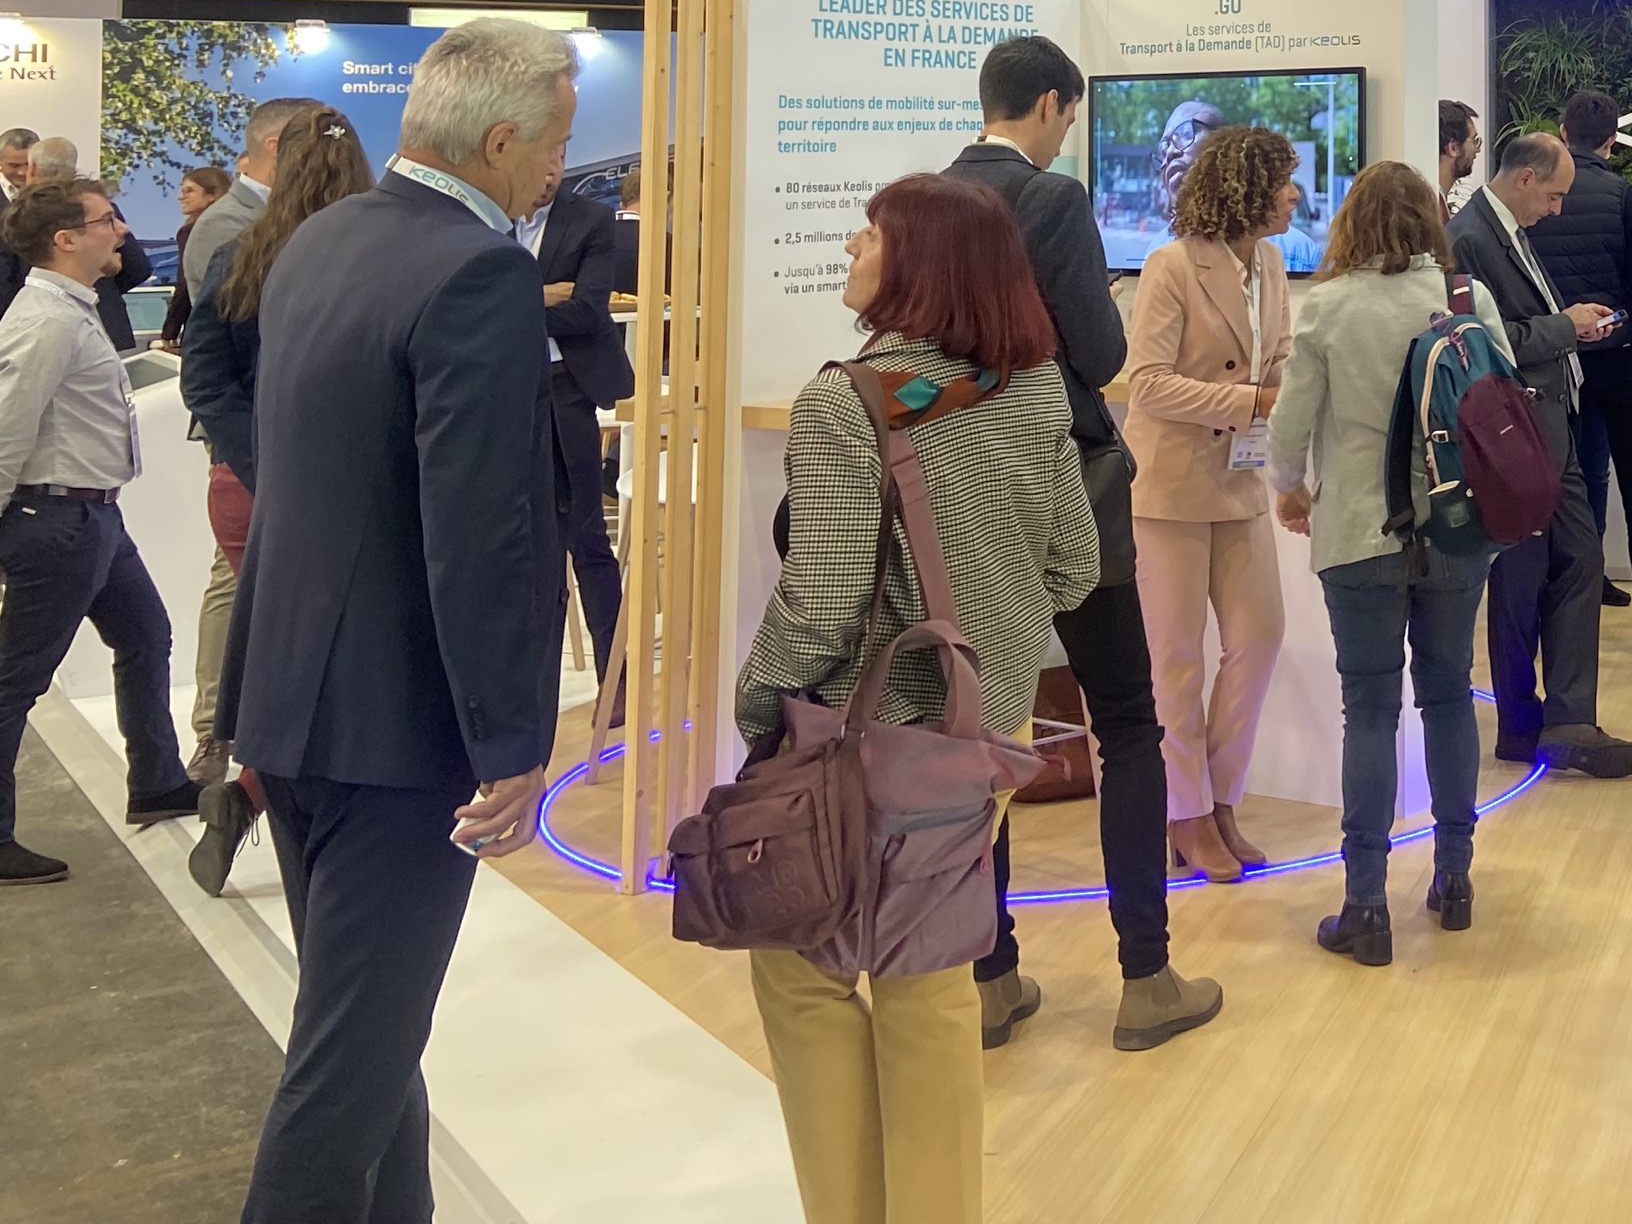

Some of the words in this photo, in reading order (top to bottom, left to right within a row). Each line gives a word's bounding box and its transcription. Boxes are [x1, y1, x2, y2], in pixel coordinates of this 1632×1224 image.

[930, 0, 1010, 22] SERVICES
[1013, 4, 1034, 23] DE
[811, 18, 919, 43] TRANSPORT
[922, 19, 934, 44] À
[937, 25, 958, 45] LA
[1186, 23, 1205, 36] Les
[1208, 22, 1255, 36] services
[1257, 20, 1272, 33] de
[1120, 41, 1174, 57] Transport
[1175, 40, 1183, 53] à
[1185, 39, 1195, 52] la
[1198, 37, 1252, 52] Demande
[1288, 36, 1308, 52] par
[884, 48, 906, 68] EN
[910, 48, 977, 69] FRANCE
[10, 66, 57, 81] Next
[342, 61, 394, 76] Smart
[778, 95, 803, 110] Des
[806, 95, 865, 110] solutions
[868, 96, 883, 110] de
[886, 95, 935, 111] mobilité
[778, 119, 809, 135] pour
[811, 117, 870, 134] répondre
[872, 120, 894, 132] aux
[897, 119, 936, 135] enjeux
[939, 117, 953, 131] de
[777, 139, 837, 154] territoire
[786, 182, 800, 194] 80
[801, 181, 842, 194] réseaux
[843, 180, 873, 192] Keolis
[785, 201, 799, 211] un
[801, 198, 836, 210] service
[838, 197, 851, 209] de
[785, 232, 802, 246] 2,5
[804, 231, 844, 243] millions
[784, 264, 824, 279] Jusqu'à
[825, 263, 848, 275] 98%
[784, 283, 800, 295] via
[801, 283, 815, 294] un
